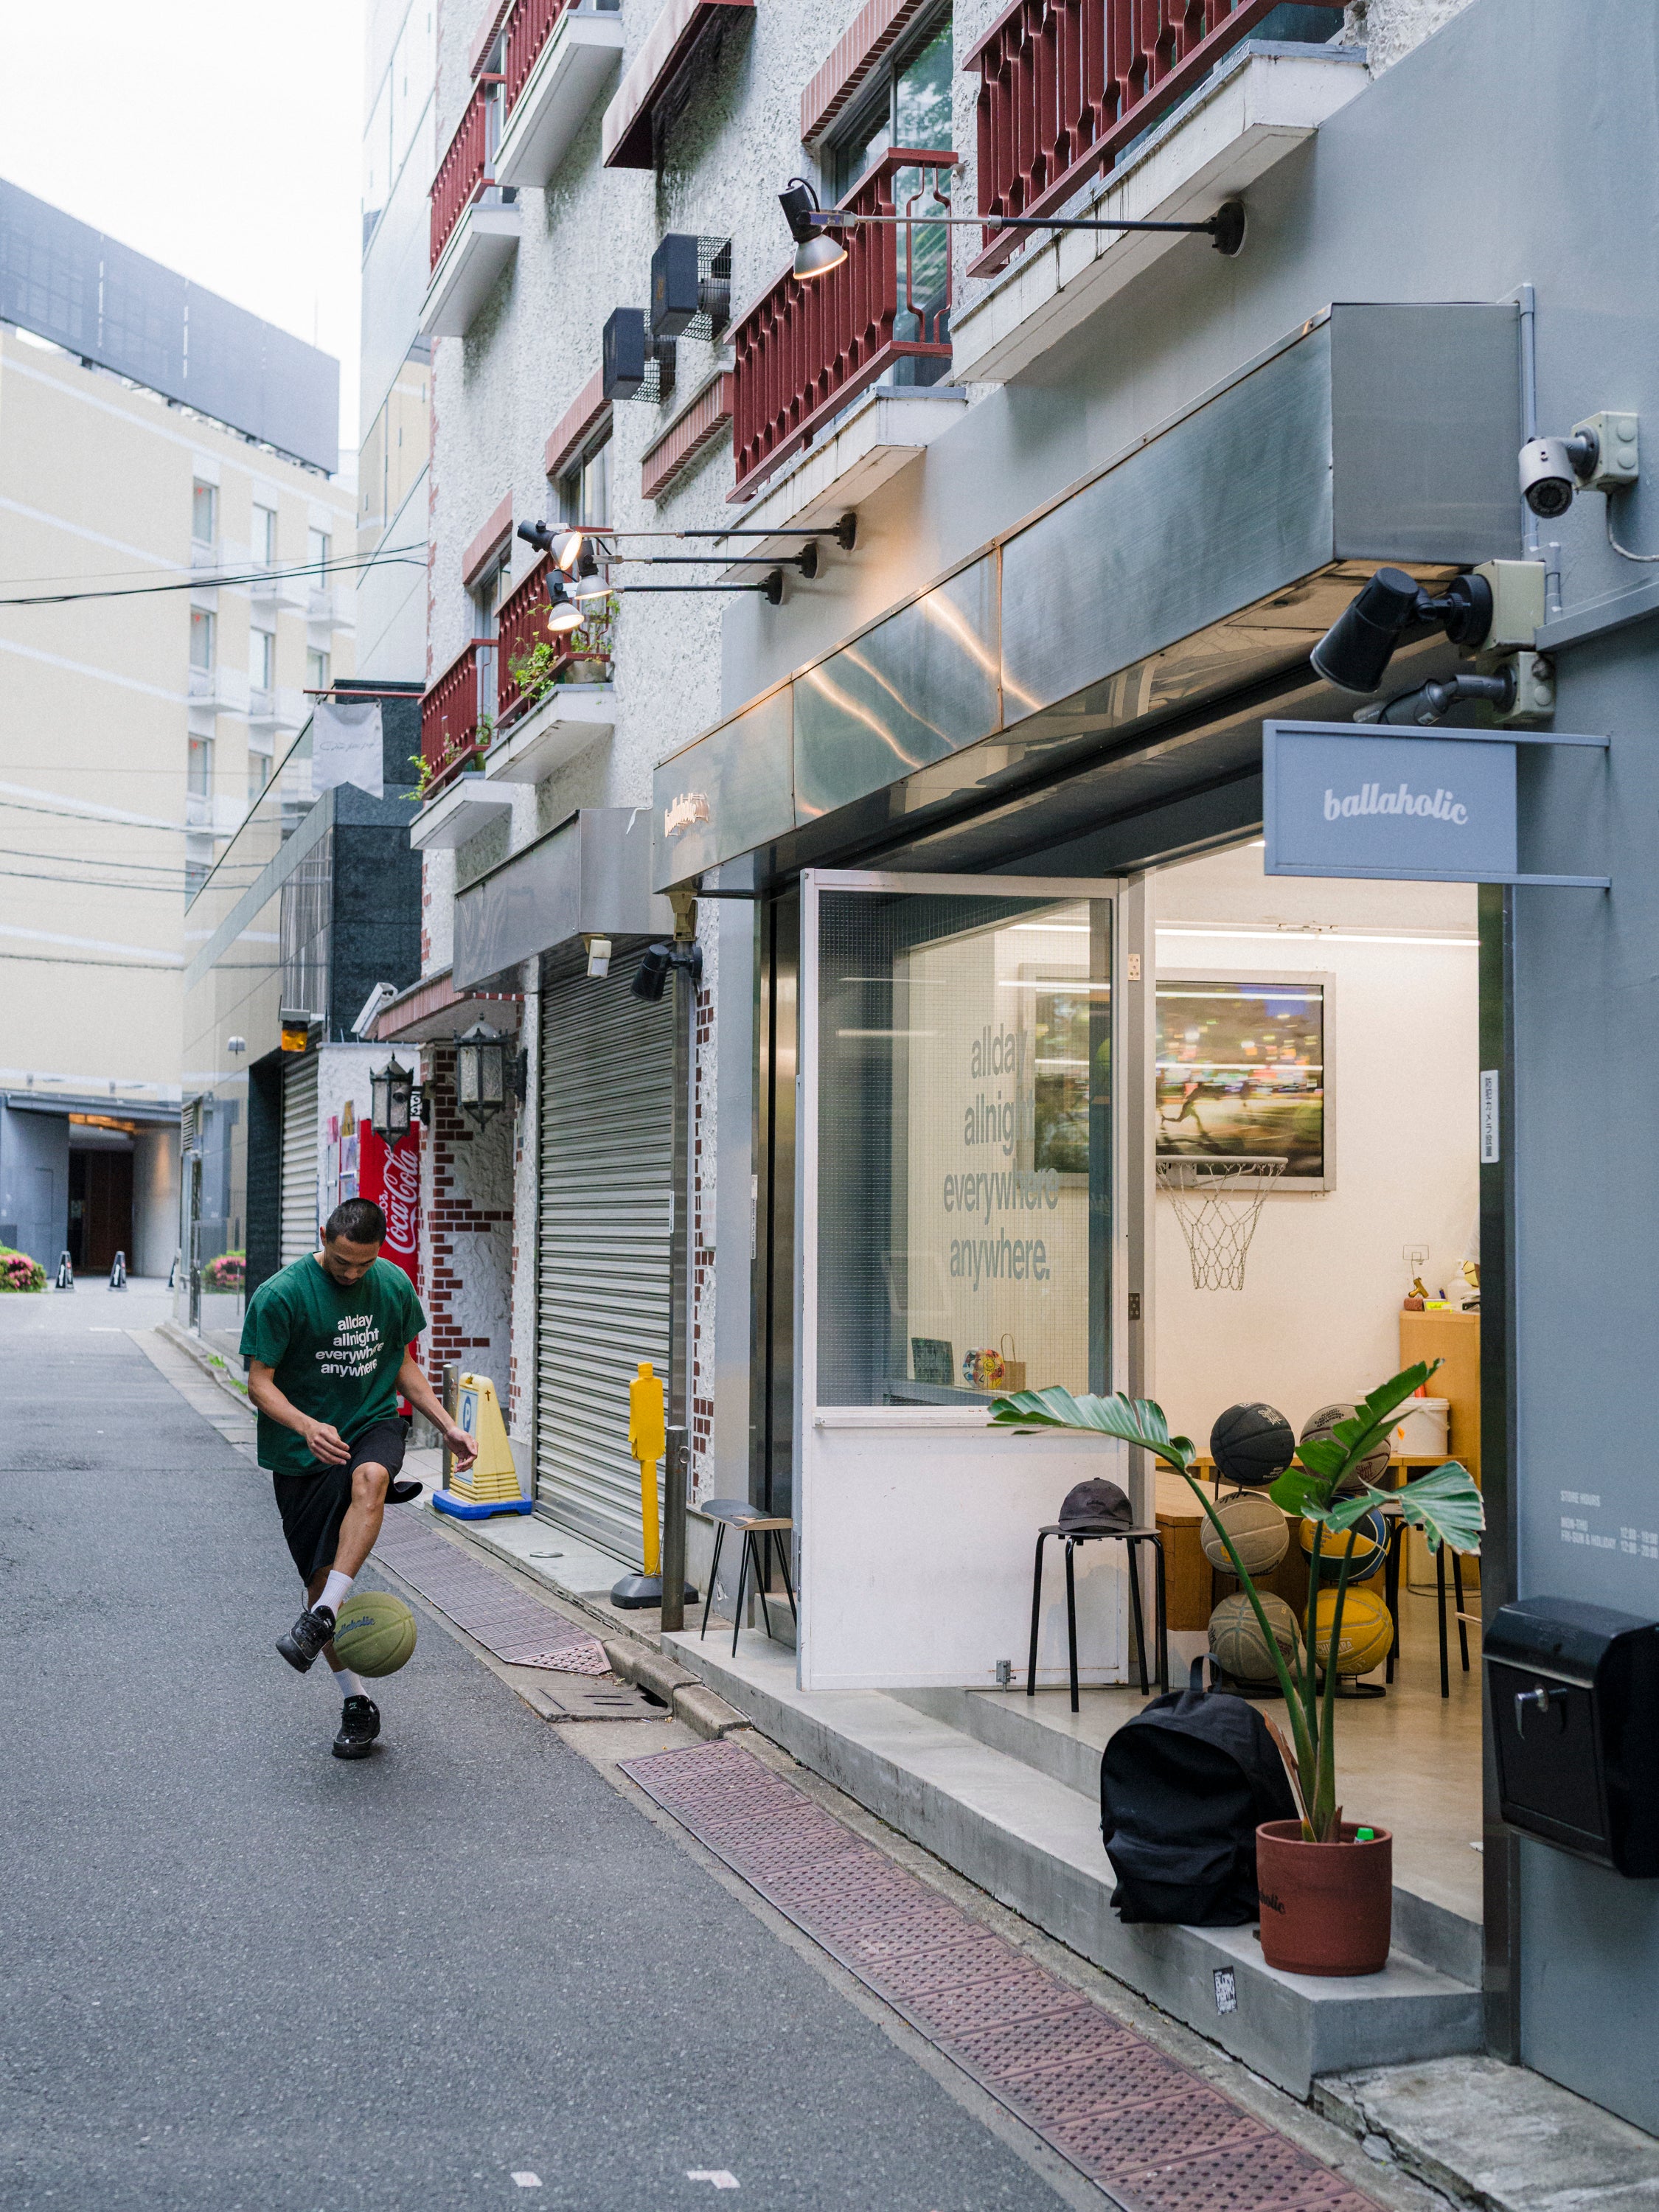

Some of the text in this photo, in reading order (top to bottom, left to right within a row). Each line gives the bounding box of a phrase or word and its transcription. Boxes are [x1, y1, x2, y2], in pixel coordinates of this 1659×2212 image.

[1324, 783, 1468, 825] ballaholic
[971, 1023, 1028, 1082] allday
[964, 1089, 1035, 1156] allnight
[943, 1158, 1060, 1225] everywhere
[950, 1228, 1051, 1292] anywhere.
[333, 1328, 380, 1346] allnight
[337, 1314, 373, 1331] allday
[321, 1359, 378, 1377] anywhere
